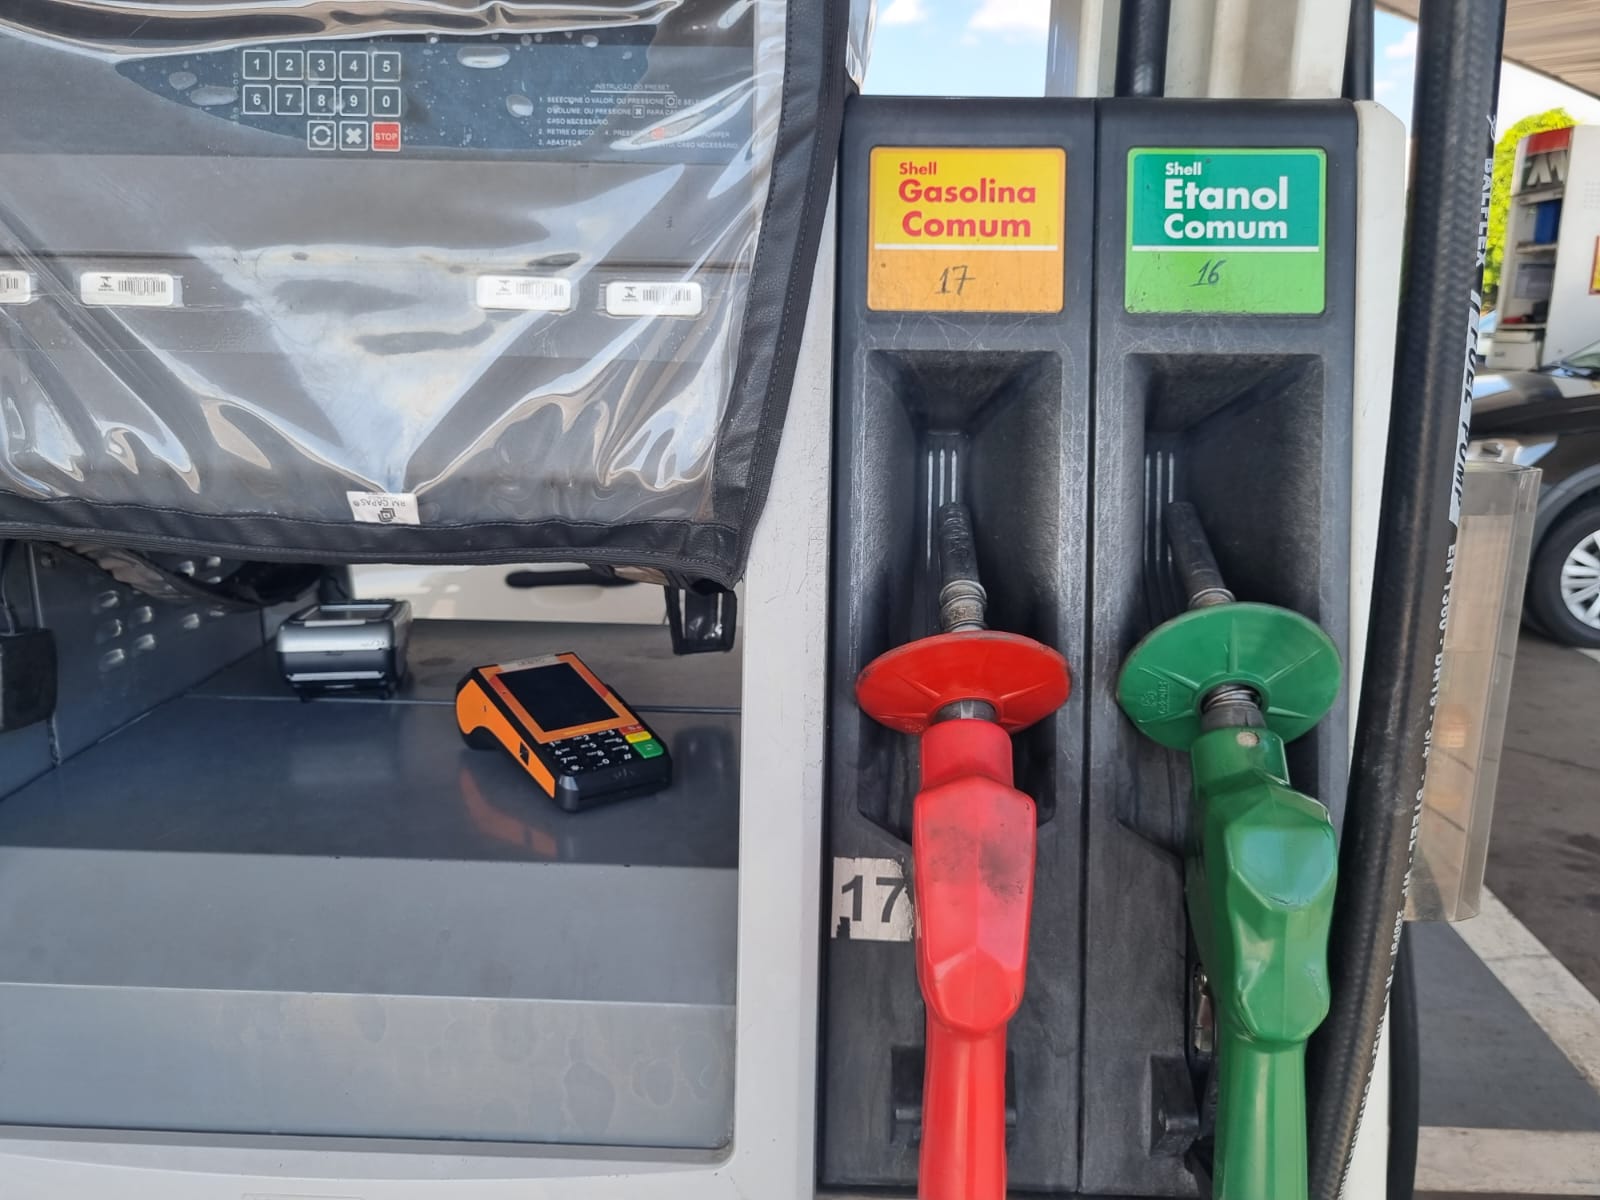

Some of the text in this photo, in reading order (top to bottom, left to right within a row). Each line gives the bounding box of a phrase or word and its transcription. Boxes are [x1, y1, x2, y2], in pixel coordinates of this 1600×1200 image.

[253, 58, 391, 73] 1 2 3 4 5
[253, 93, 391, 108] 6 7 8 9 0
[375, 131, 398, 142] STOP
[899, 161, 937, 175] Shell
[1164, 161, 1202, 176] Shell
[898, 177, 1036, 203] Gasolina
[1164, 175, 1289, 210] Etanol
[902, 210, 1032, 238] Comum
[1163, 212, 1288, 239] Comum
[1475, 157, 1494, 267] BALFLEX
[935, 264, 976, 295] 17
[1188, 259, 1227, 287] 16
[841, 874, 904, 923] 17
